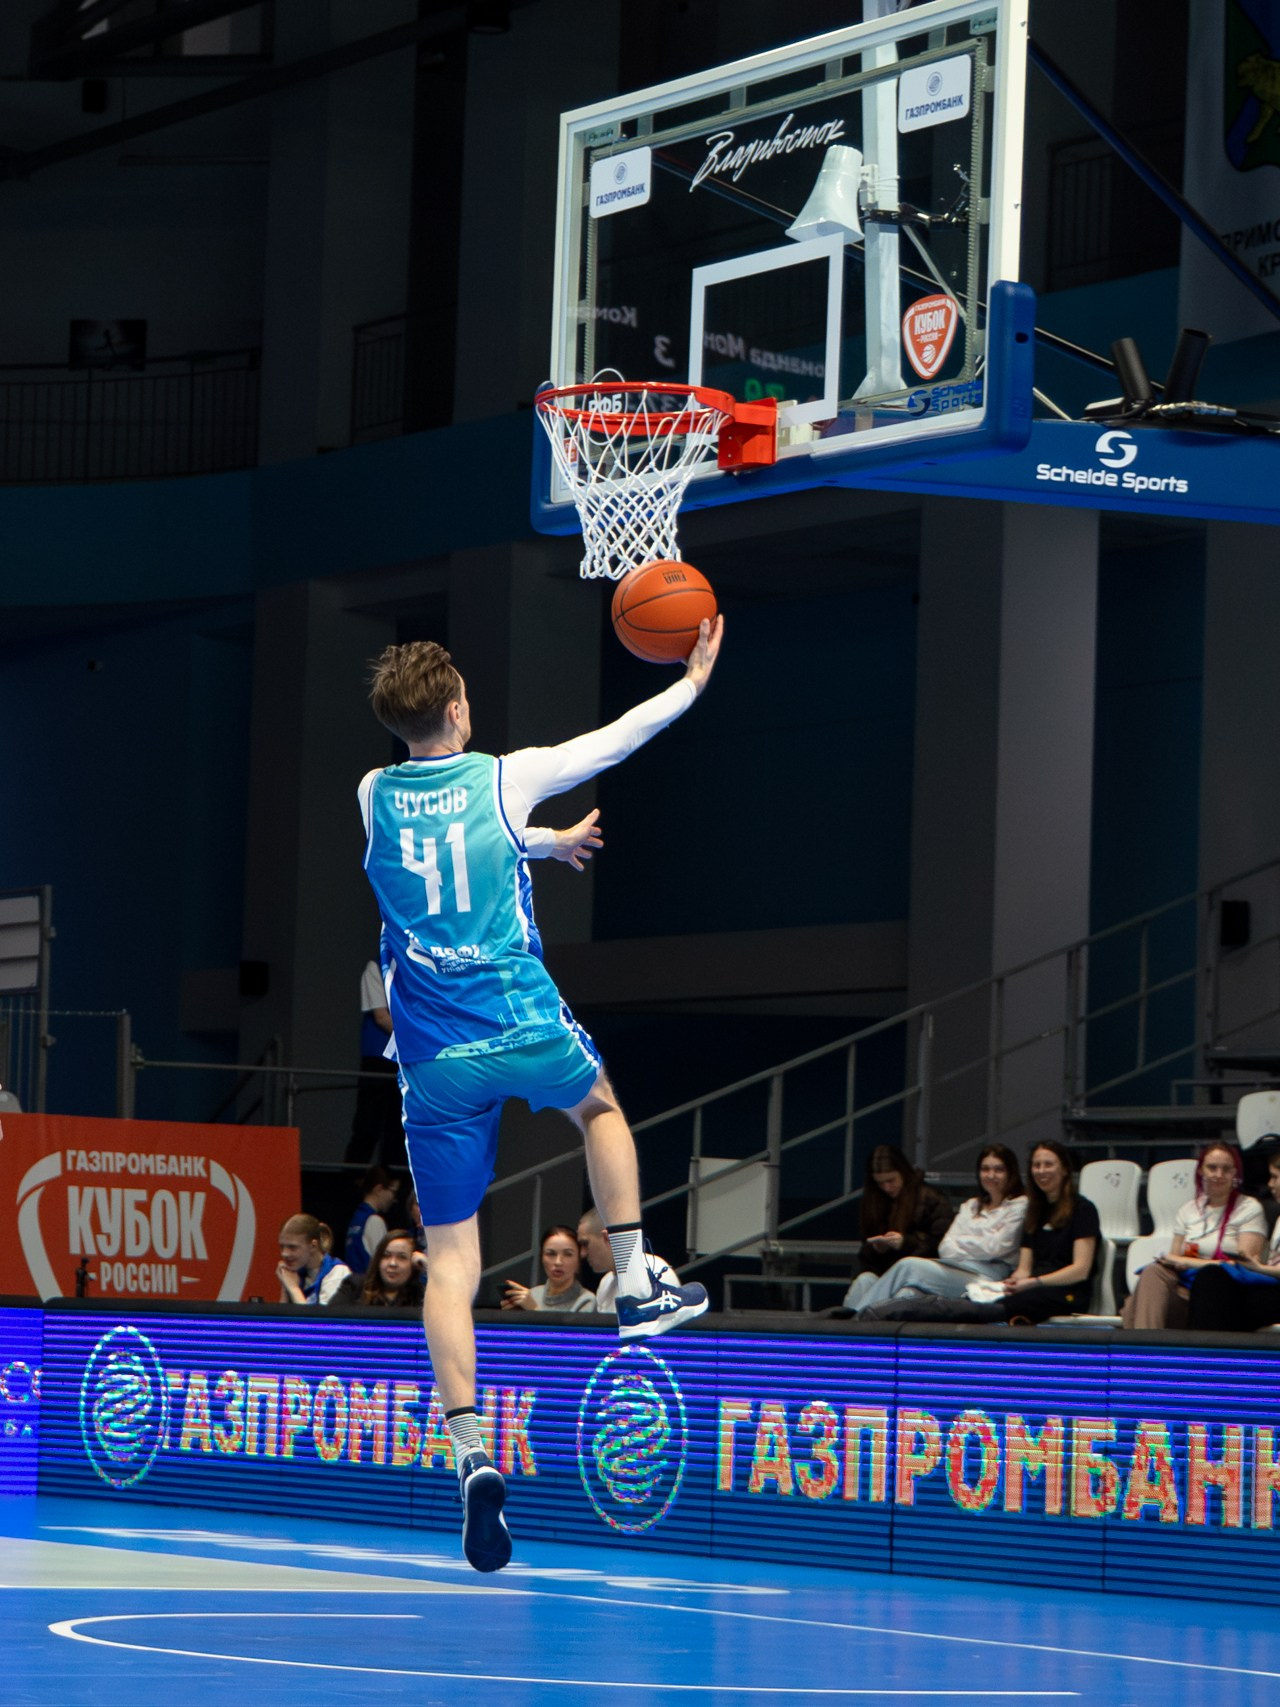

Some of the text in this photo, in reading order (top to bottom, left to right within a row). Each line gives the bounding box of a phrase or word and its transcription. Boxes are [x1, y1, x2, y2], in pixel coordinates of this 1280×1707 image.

[904, 94, 964, 121] ГАЗПРОМБАНК
[688, 113, 846, 193] Владивосток
[595, 182, 646, 207] ГАЗПРОМБАНК
[913, 308, 946, 335] КУБОК
[1036, 463, 1189, 493] Schelde Sports
[394, 786, 468, 818] ЧУСОВ
[400, 822, 471, 916] 41
[67, 1149, 207, 1178] ГАЗПРОМБАНК
[67, 1185, 209, 1260] КУБОК
[100, 1261, 178, 1294] РОССИИ
